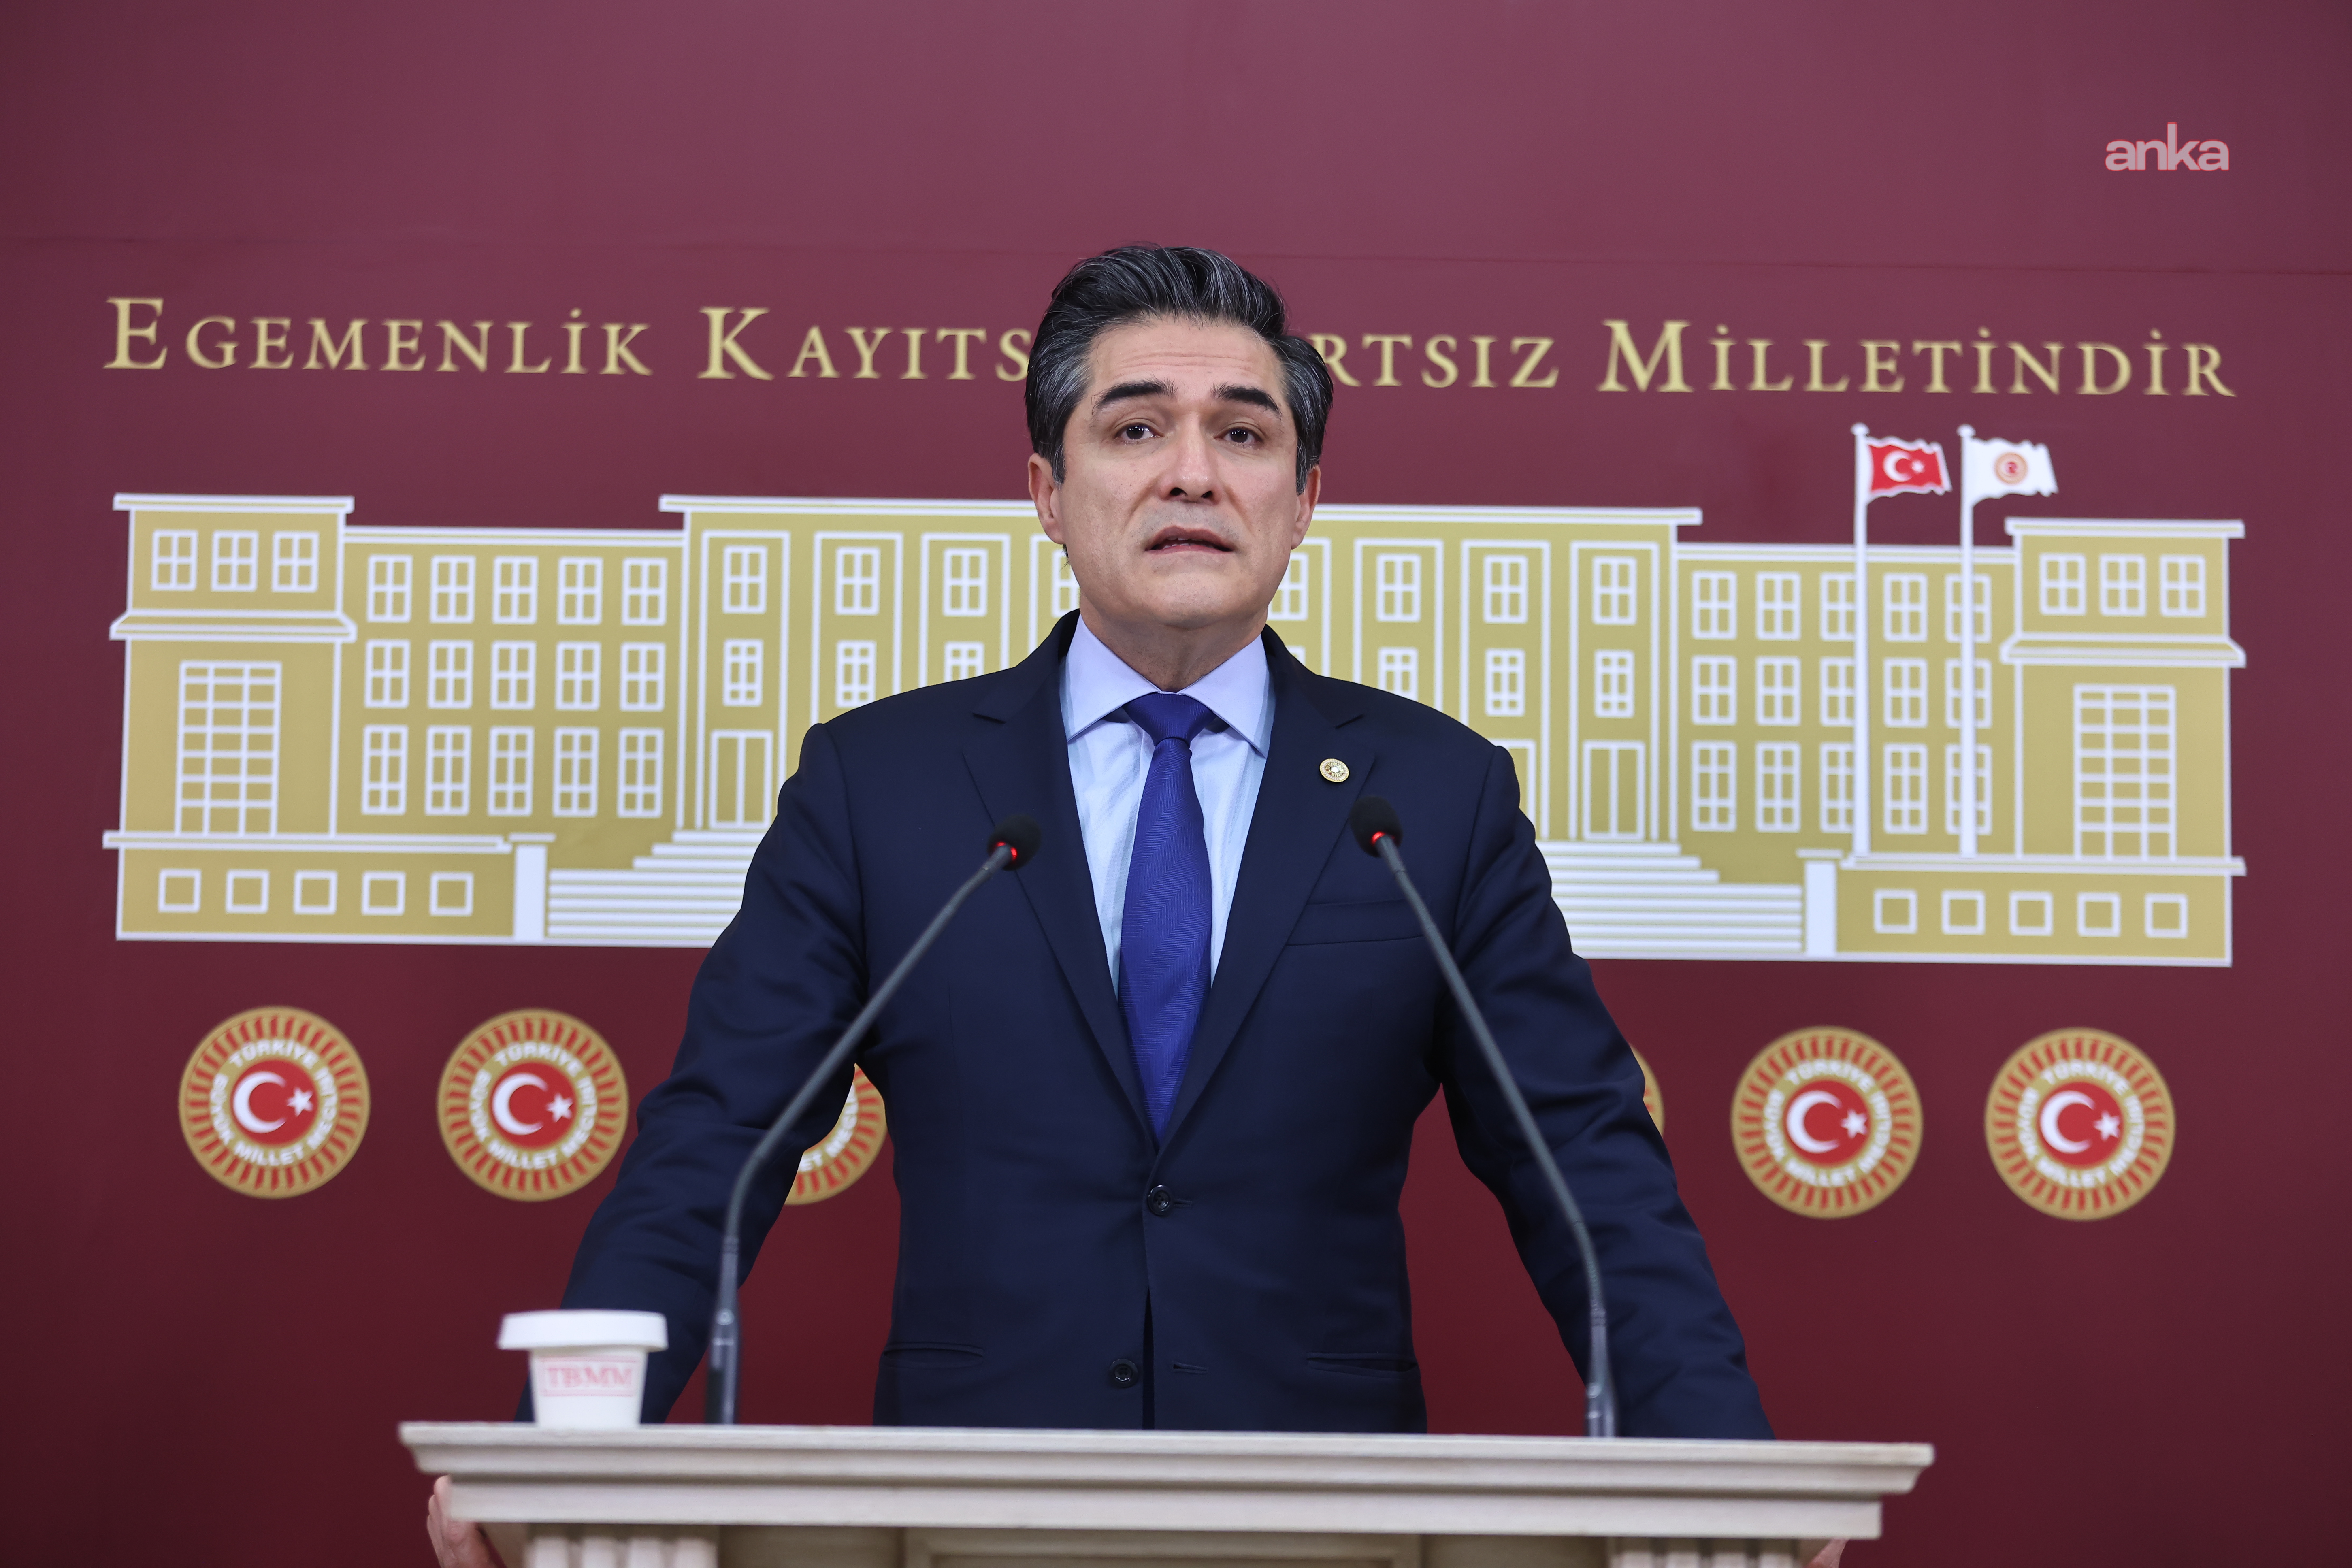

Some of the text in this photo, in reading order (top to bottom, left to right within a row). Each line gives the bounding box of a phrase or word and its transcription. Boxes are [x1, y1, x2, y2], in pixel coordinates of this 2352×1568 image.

[104, 297, 2236, 397] EGEMENLİK KAYITS RTSIZ MİLLETİNDİR
